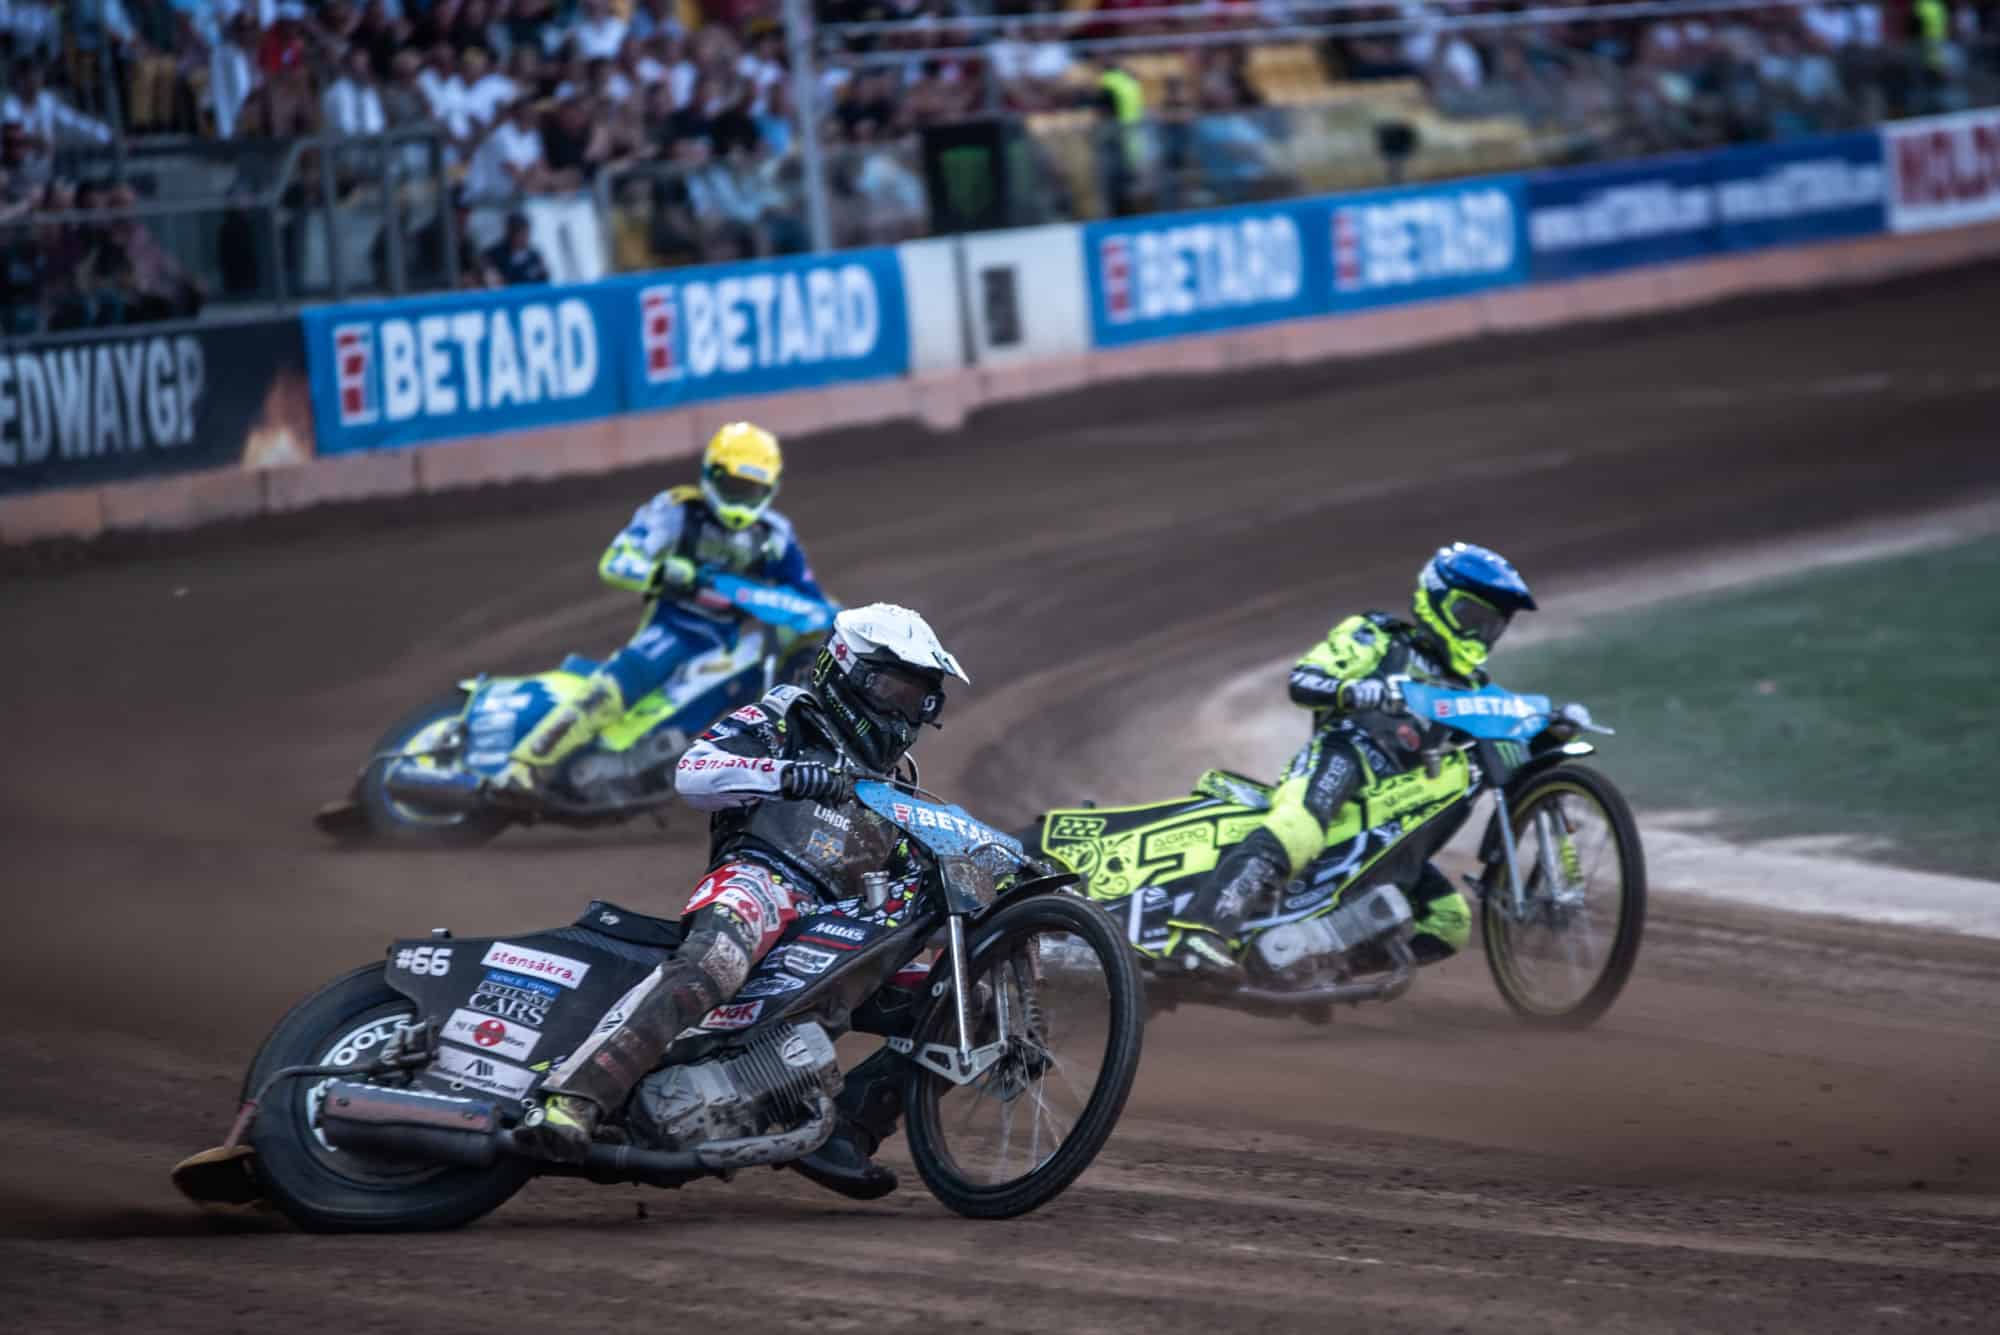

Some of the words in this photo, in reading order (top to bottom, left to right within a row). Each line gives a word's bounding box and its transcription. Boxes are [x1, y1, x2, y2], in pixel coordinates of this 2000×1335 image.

[1132, 216, 1302, 319] BETARD
[1363, 190, 1515, 286] BETARD
[379, 298, 599, 423] BETARD
[683, 265, 879, 378] BETARD
[396, 946, 453, 977] #66
[468, 991, 544, 1025] CARS
